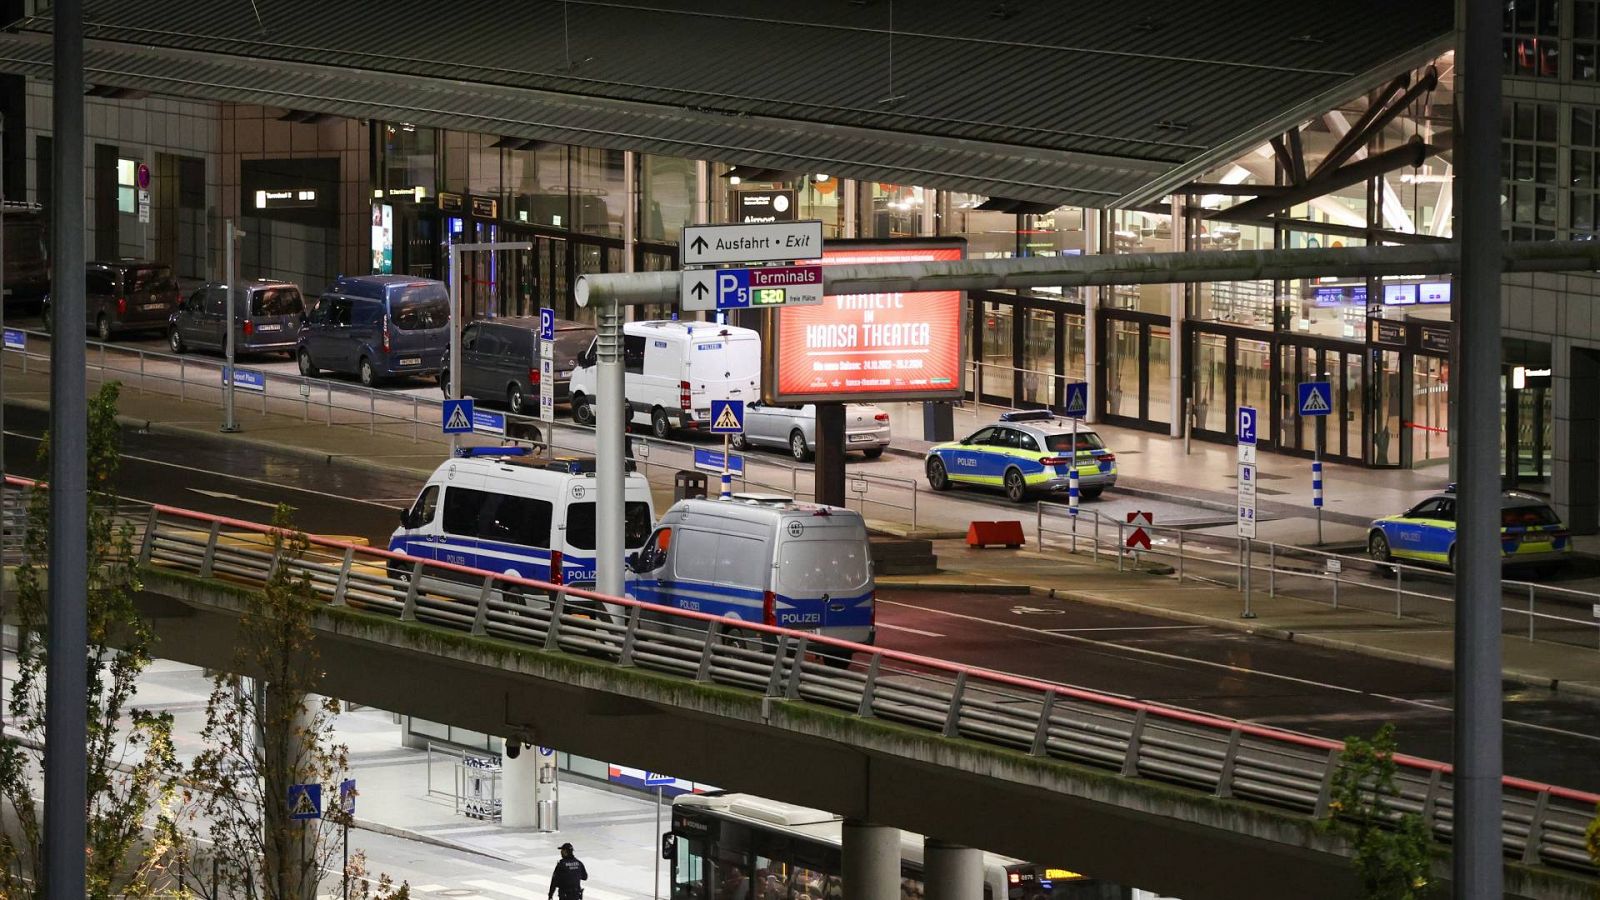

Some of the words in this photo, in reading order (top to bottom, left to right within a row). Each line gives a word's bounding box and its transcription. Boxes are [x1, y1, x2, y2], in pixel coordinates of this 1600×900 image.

[715, 237, 770, 250] Ausfahrt
[786, 234, 811, 248] Exit
[753, 269, 815, 284] Terminals
[760, 289, 784, 303] 520
[806, 323, 858, 348] HANSA
[862, 322, 930, 346] THEATER
[957, 457, 977, 467] POLIZEI
[1401, 531, 1421, 542] POLIZEI
[446, 554, 465, 566] POLIZEI
[568, 570, 597, 580] POLIZ
[680, 599, 700, 611] POLIZEI
[781, 613, 821, 623] POLIZEI
